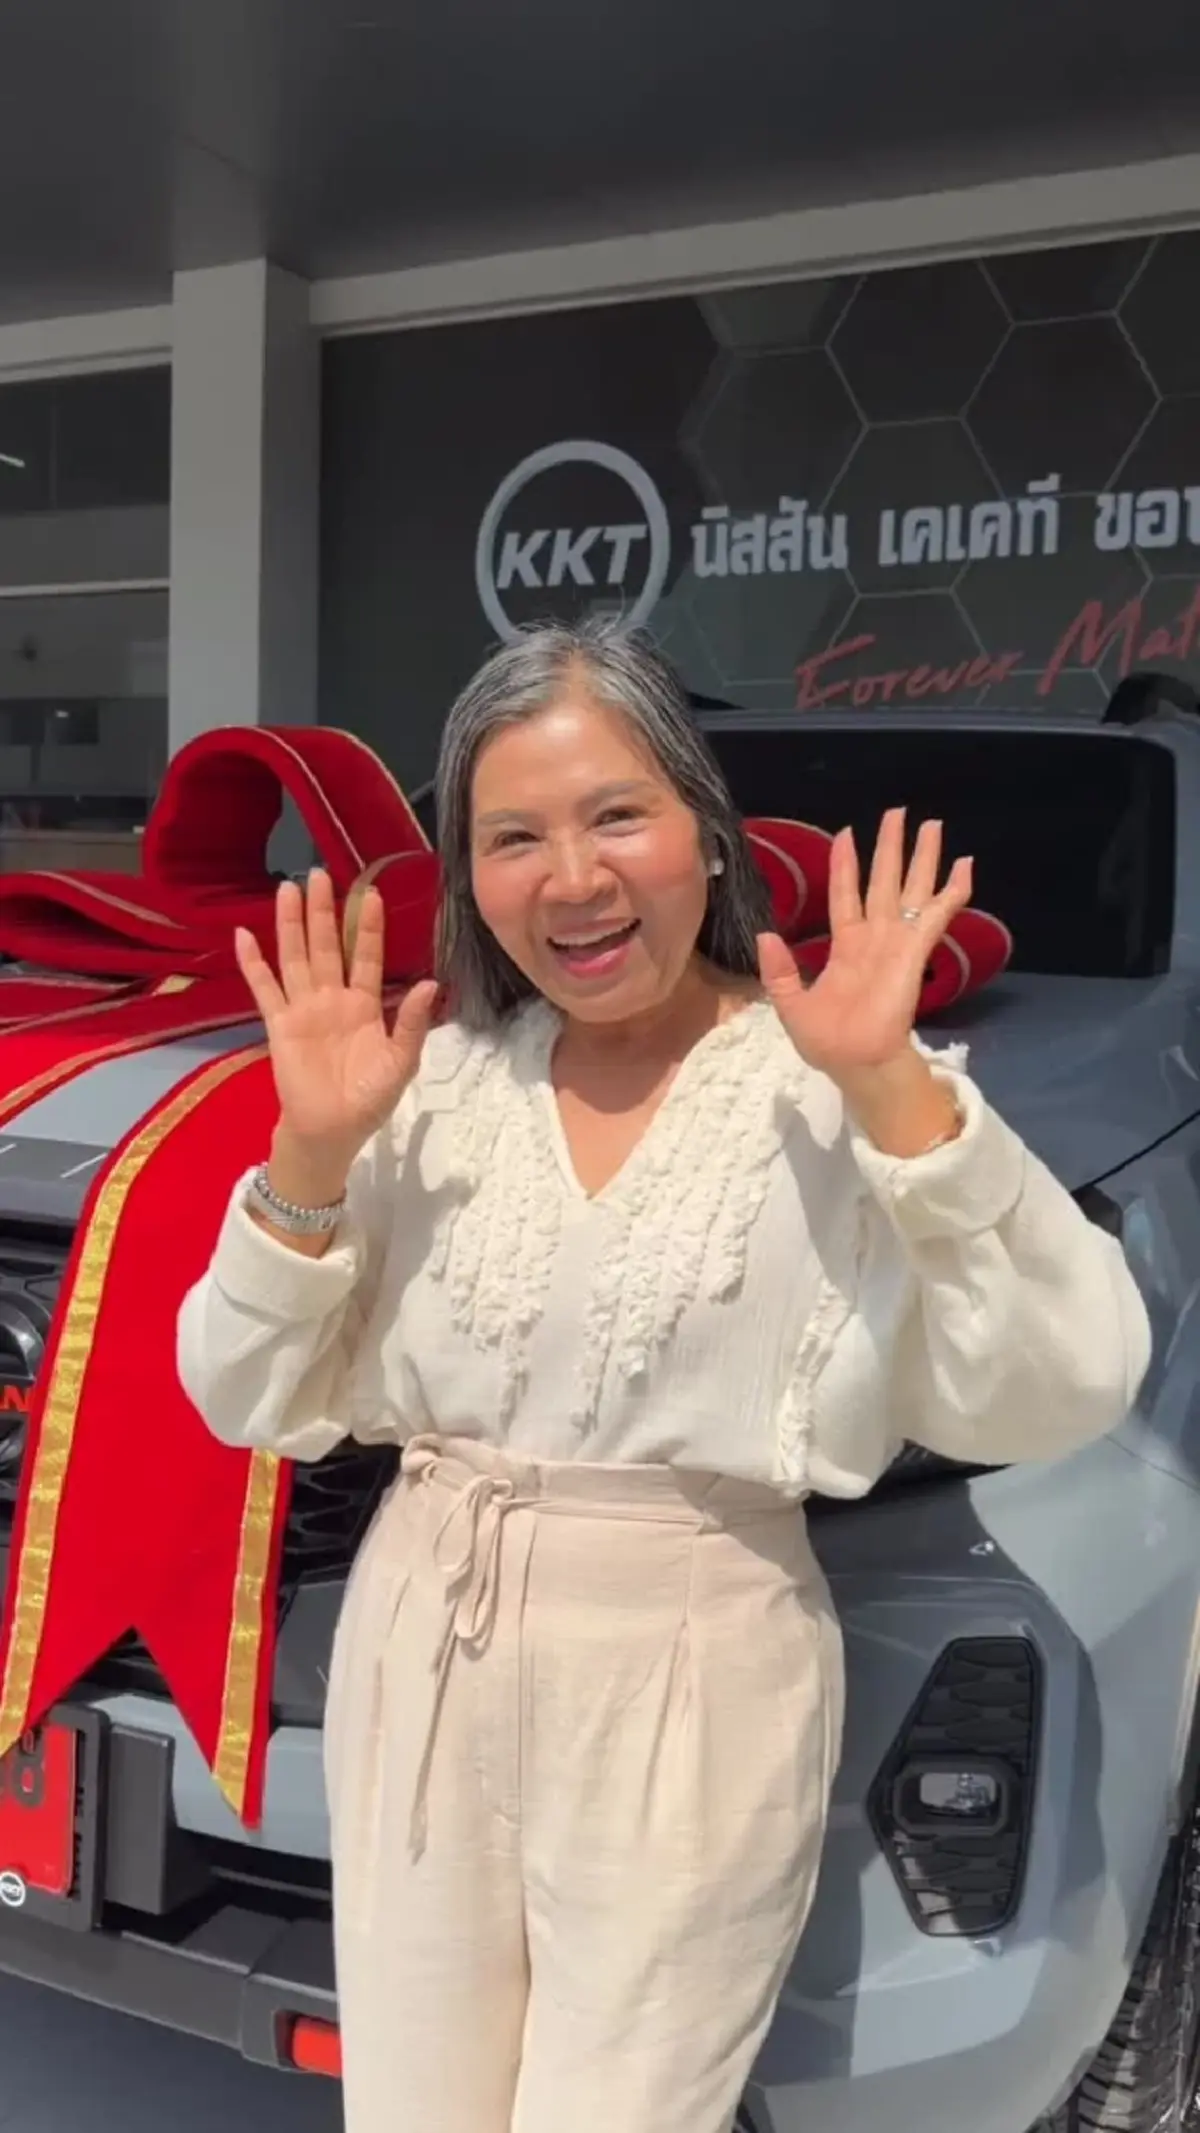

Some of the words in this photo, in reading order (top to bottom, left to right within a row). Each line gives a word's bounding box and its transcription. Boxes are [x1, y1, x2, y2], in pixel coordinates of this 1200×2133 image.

[497, 524, 648, 590] KKT
[691, 495, 849, 578] นิสสัน
[878, 472, 1061, 567] เคเคที
[795, 633, 1025, 711] Forever
